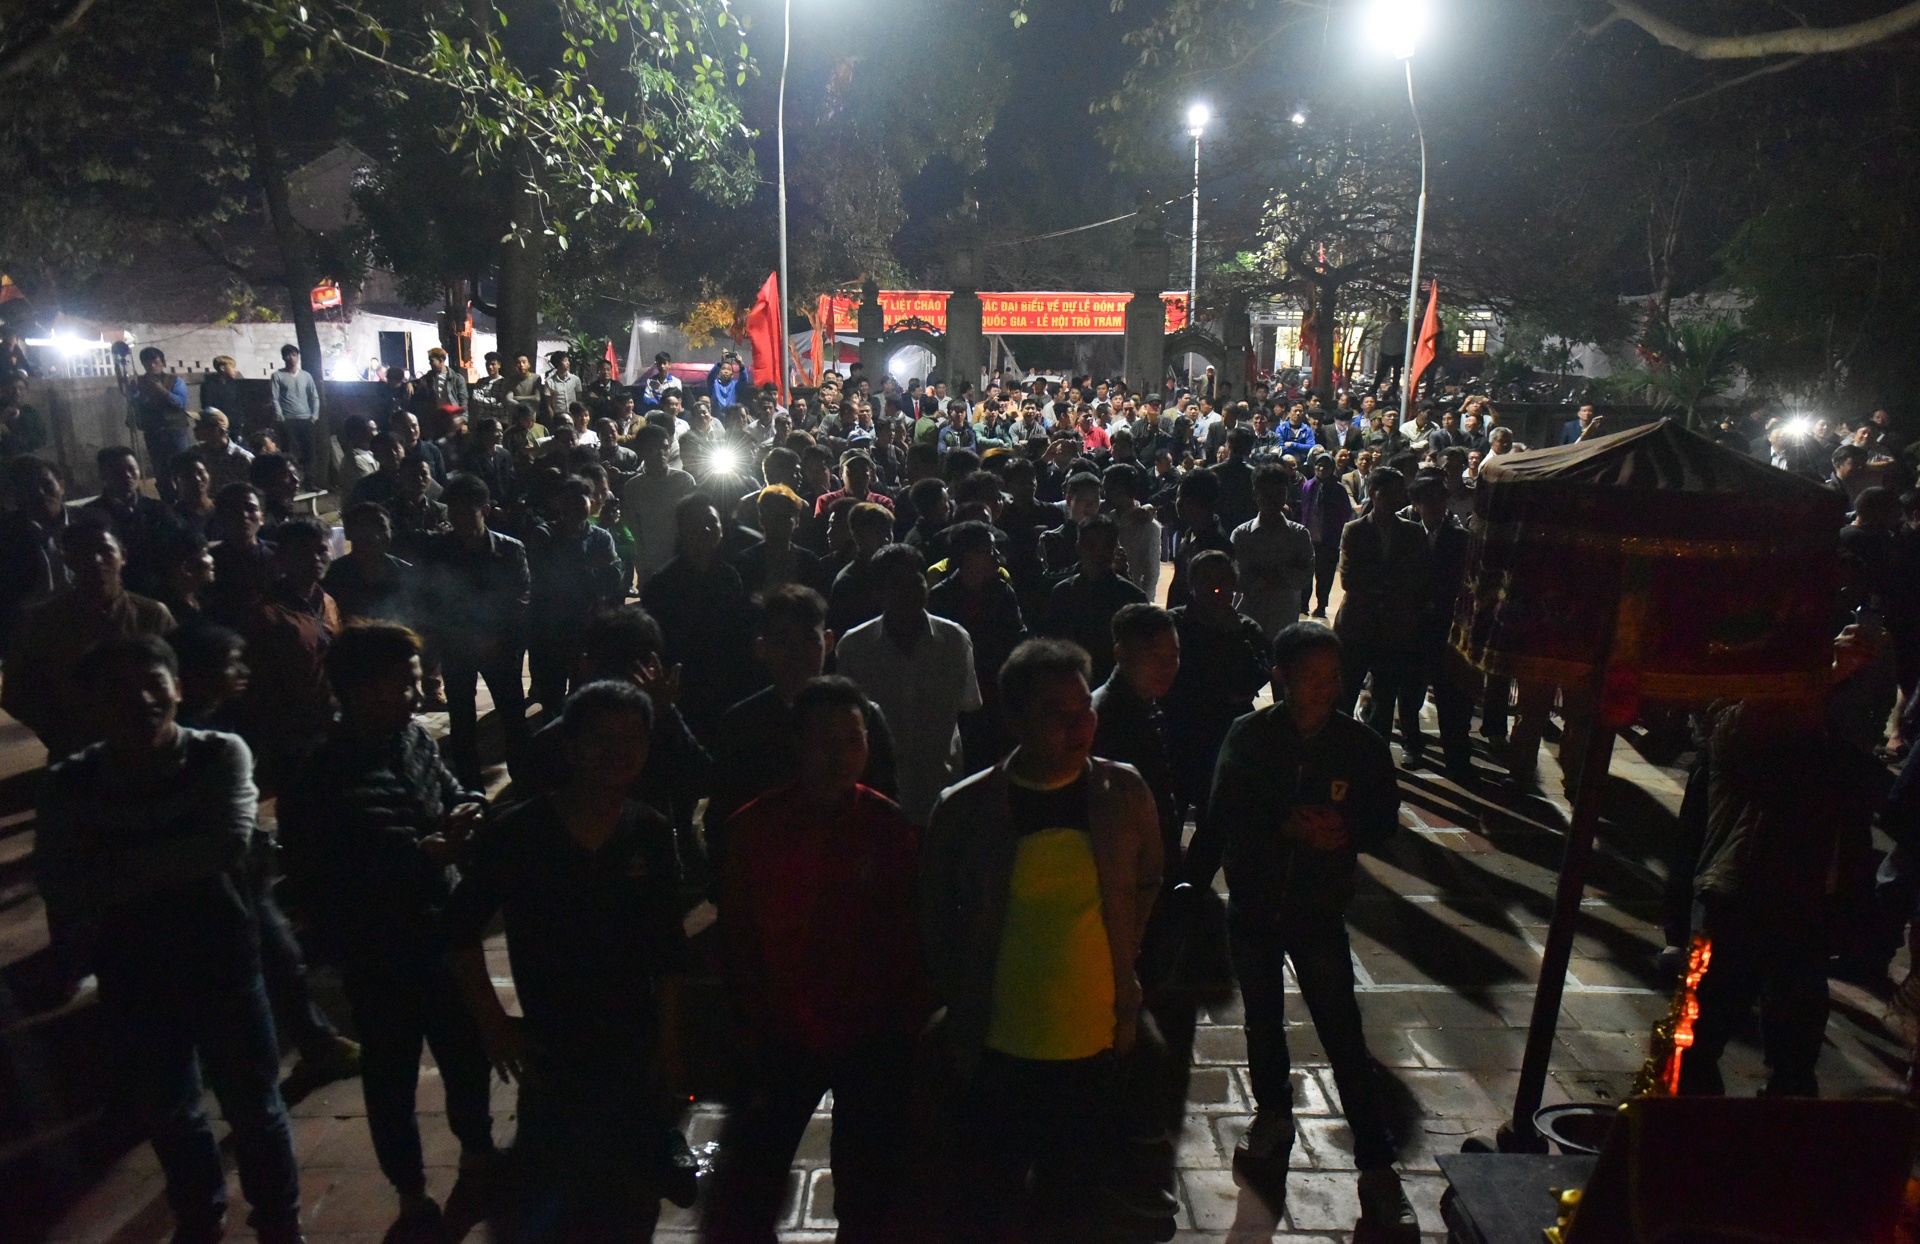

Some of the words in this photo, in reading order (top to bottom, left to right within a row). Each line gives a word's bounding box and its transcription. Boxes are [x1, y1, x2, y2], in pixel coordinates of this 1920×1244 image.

[891, 298, 912, 312] LIỆT
[914, 299, 941, 311] CHÀO
[1001, 301, 1018, 314] ĐẠI
[1021, 298, 1044, 312] BIỂU
[1062, 301, 1078, 314] DỰ
[1079, 299, 1091, 312] LỄ
[1093, 300, 1114, 312] ĐÓN
[982, 312, 1008, 327] QUỐC
[1010, 316, 1027, 327] GIA
[1037, 313, 1048, 327] LỄ
[1051, 314, 1068, 328] HỘI
[1071, 314, 1090, 327] TRÒ
[1093, 314, 1122, 327] TRÁM
